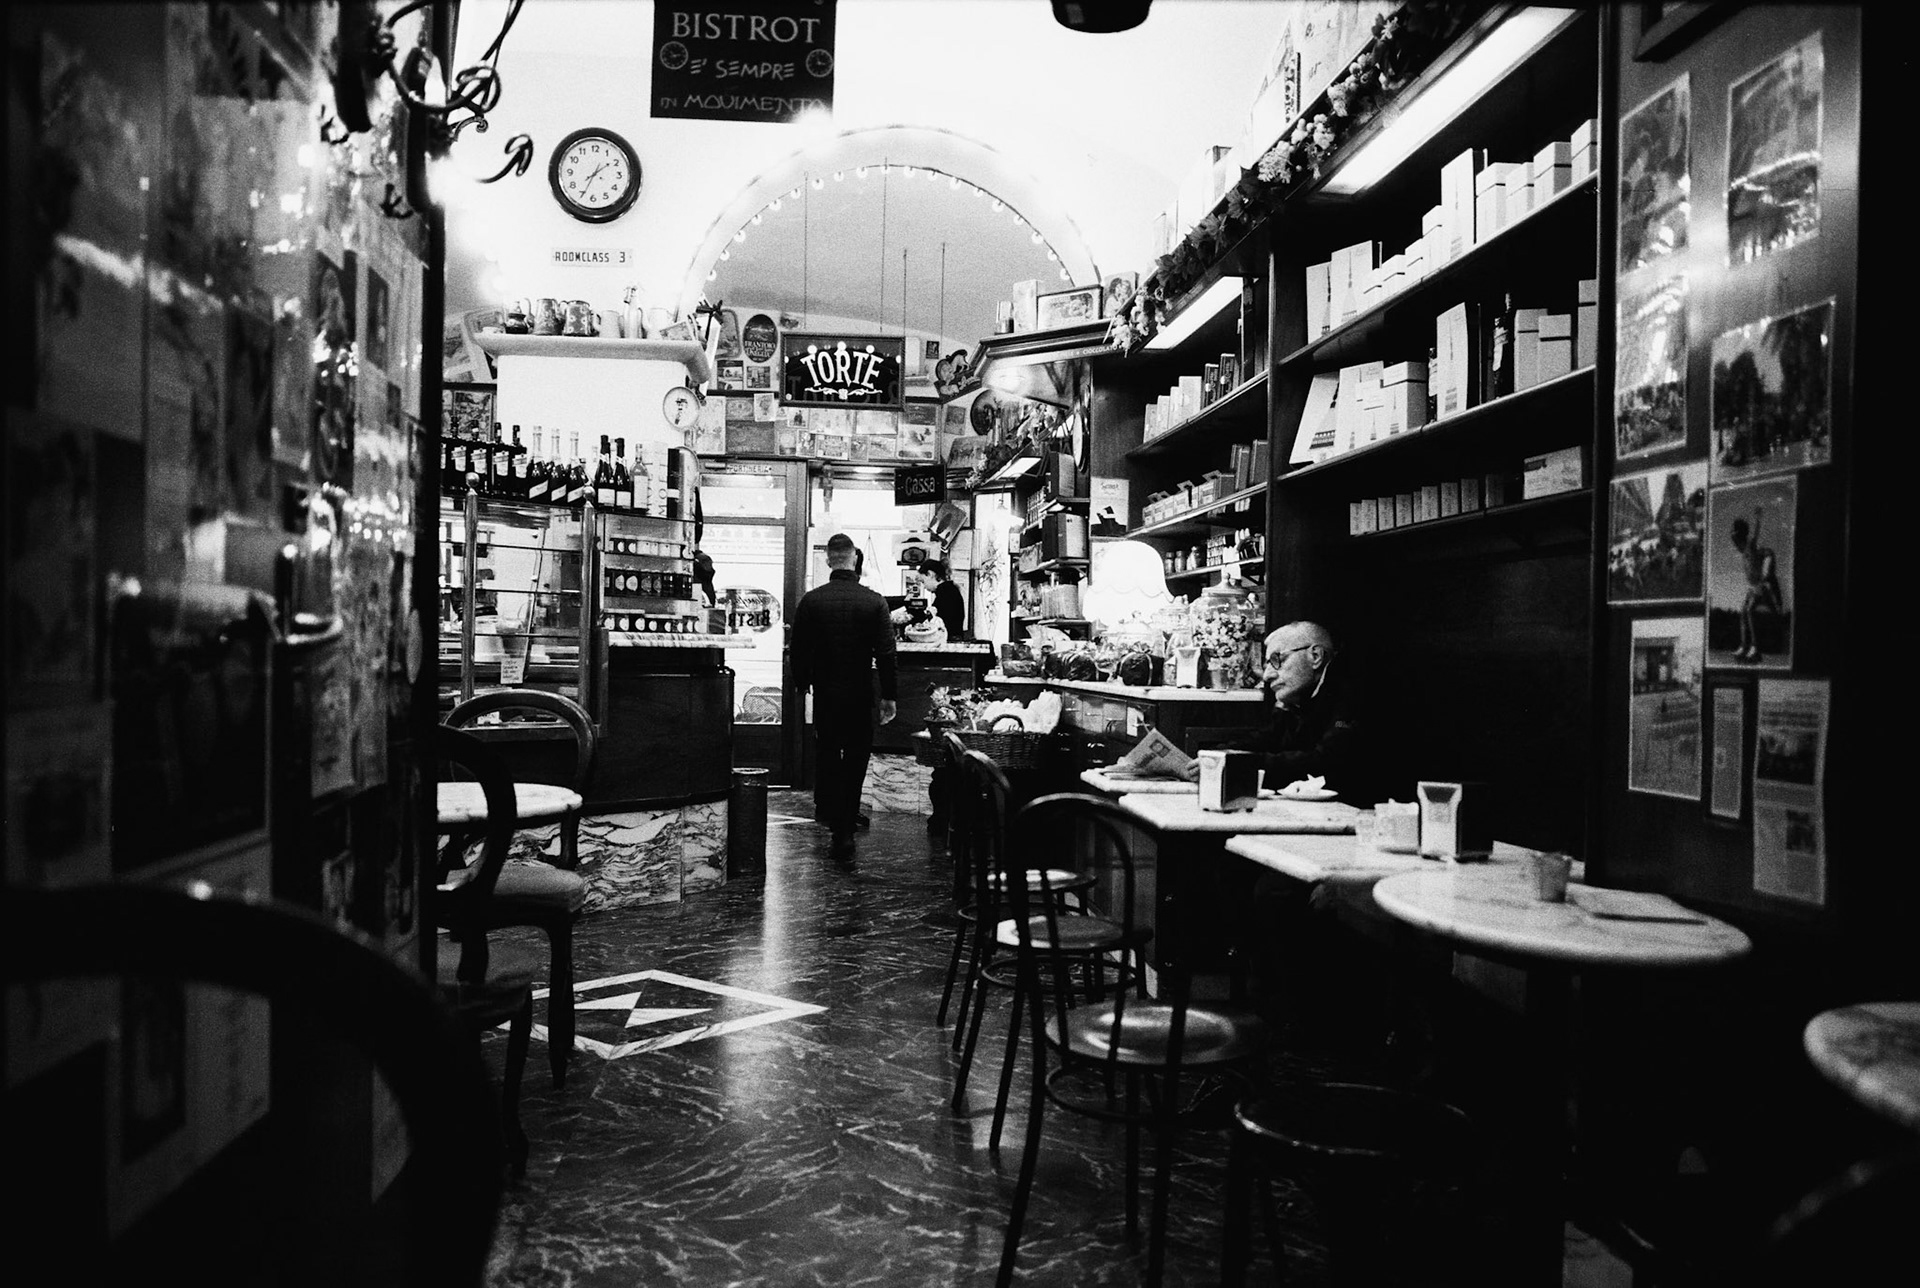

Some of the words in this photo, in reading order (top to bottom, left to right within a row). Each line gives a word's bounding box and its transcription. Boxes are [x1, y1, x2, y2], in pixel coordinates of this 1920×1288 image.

[672, 12, 820, 43] BISTROT
[715, 60, 795, 80] SEMPRE
[579, 147, 586, 155] 11
[591, 145, 600, 153] 12
[570, 156, 579, 164] 10
[555, 251, 610, 263] ROOMCLASS
[619, 251, 626, 263] 3
[800, 350, 884, 389] TORTE
[905, 476, 936, 496] Cassa
